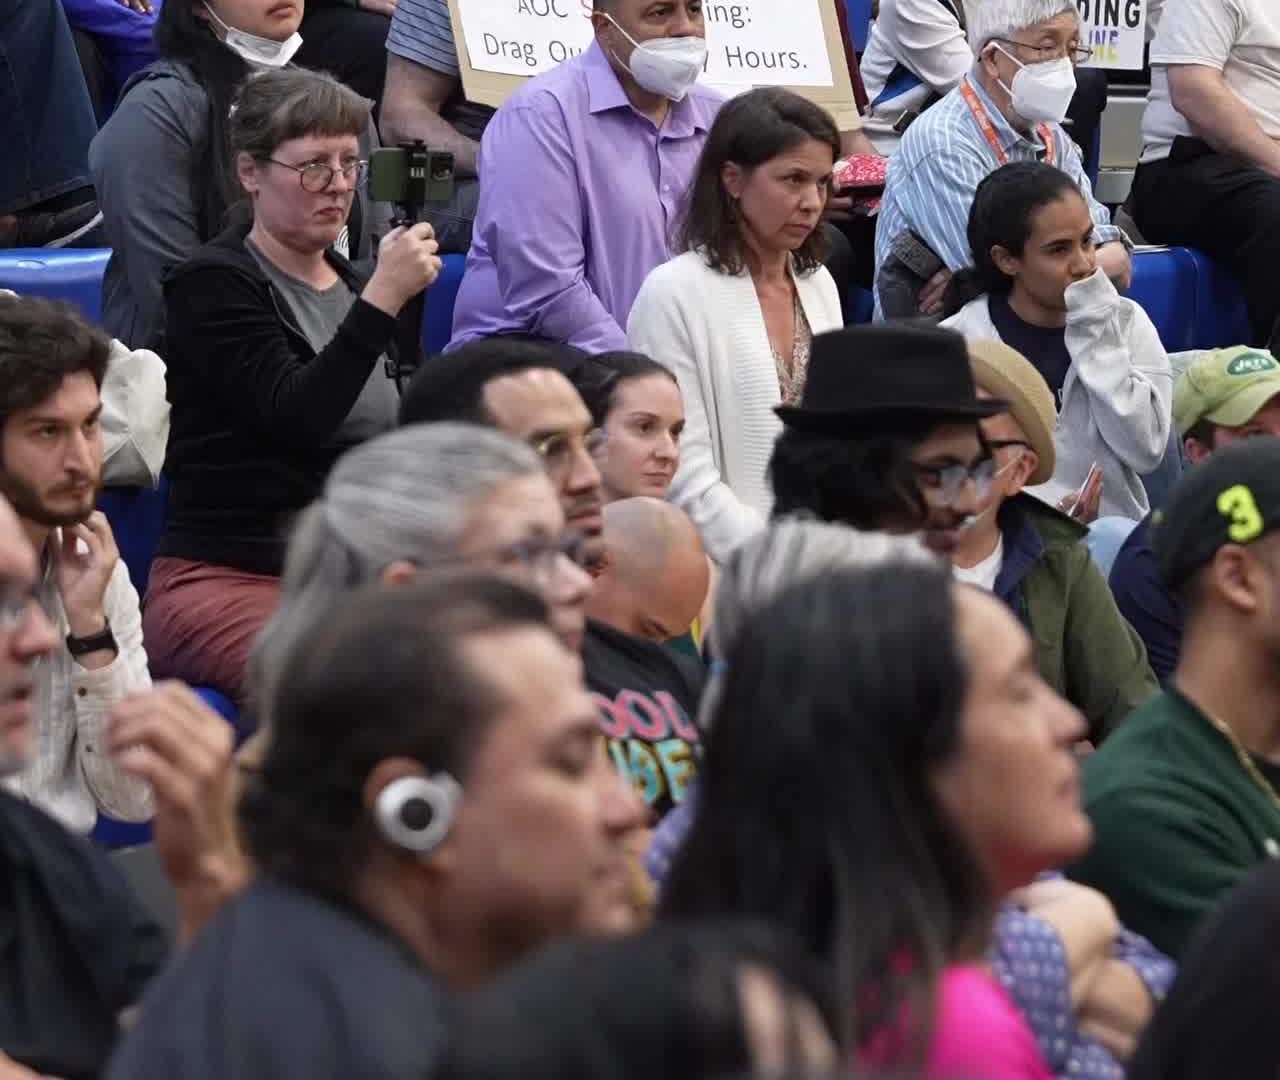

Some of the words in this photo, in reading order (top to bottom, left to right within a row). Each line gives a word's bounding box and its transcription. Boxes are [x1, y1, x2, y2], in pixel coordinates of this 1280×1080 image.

[483, 32, 537, 67] Drag
[725, 45, 808, 69] Hours.
[1216, 484, 1265, 543] 3
